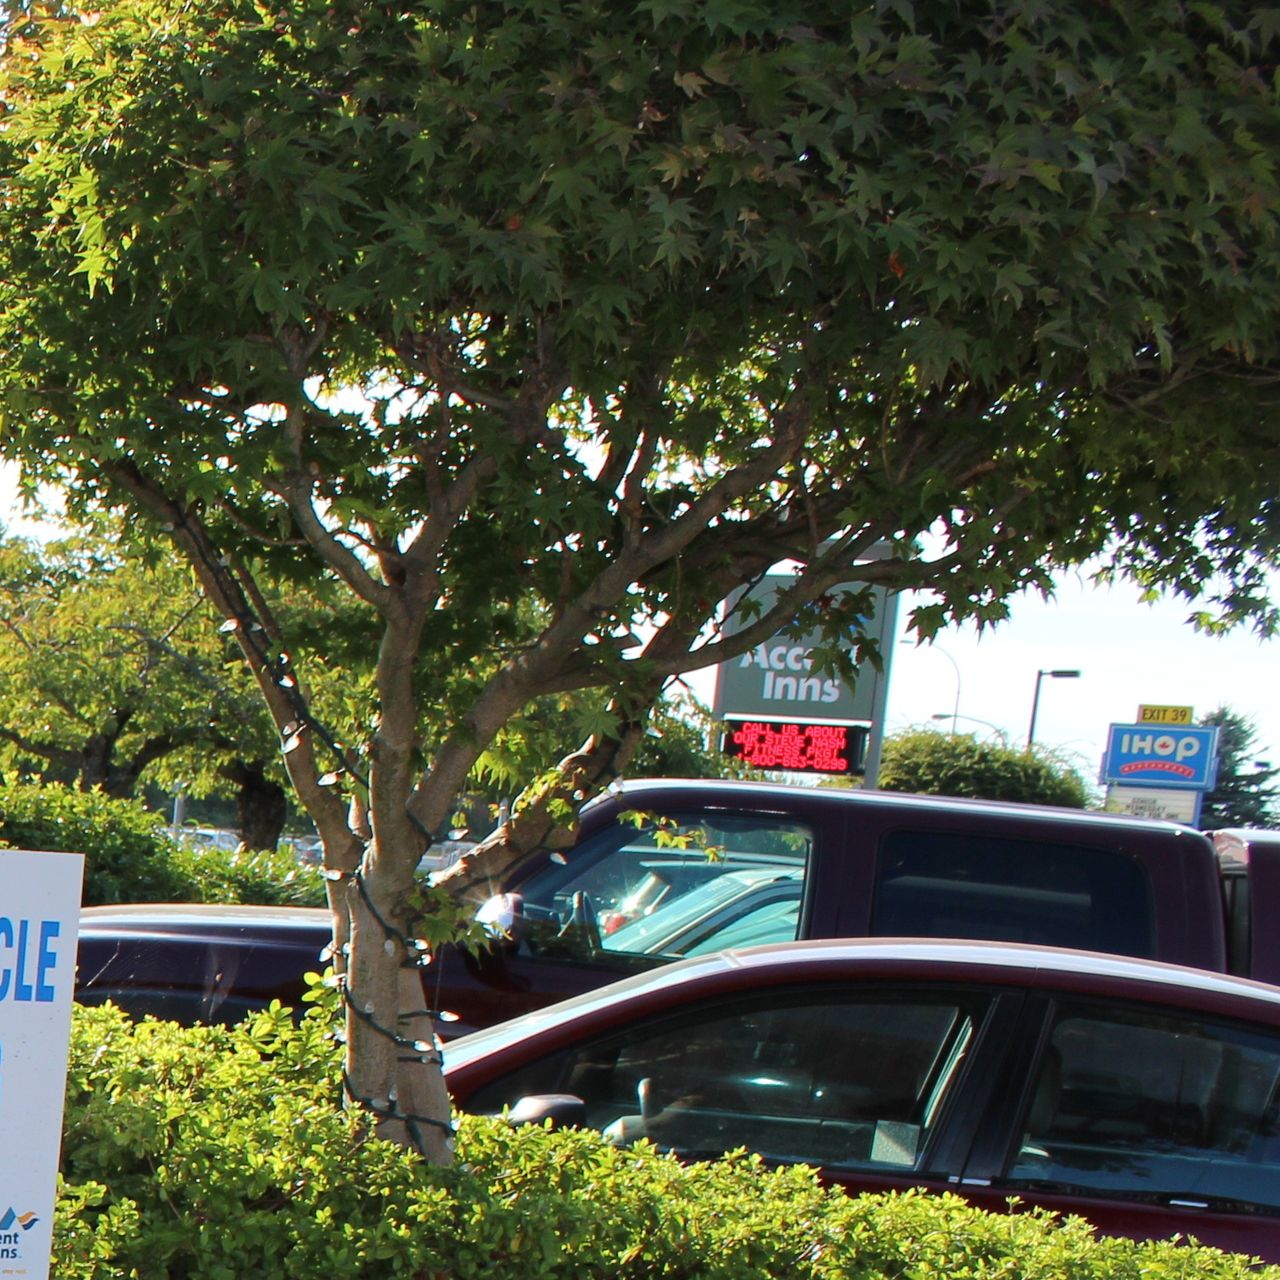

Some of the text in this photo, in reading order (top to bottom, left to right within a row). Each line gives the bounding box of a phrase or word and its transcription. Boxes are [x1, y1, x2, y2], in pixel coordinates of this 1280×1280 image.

[739, 641, 861, 670] Acct
[763, 672, 840, 703] Inns
[1142, 708, 1188, 722] EXIT 39
[742, 722, 847, 738] CALL US ABOUT
[733, 731, 846, 750] OUR STEVE NASH
[744, 743, 801, 757] FITNESS
[1121, 734, 1200, 762] IHOP
